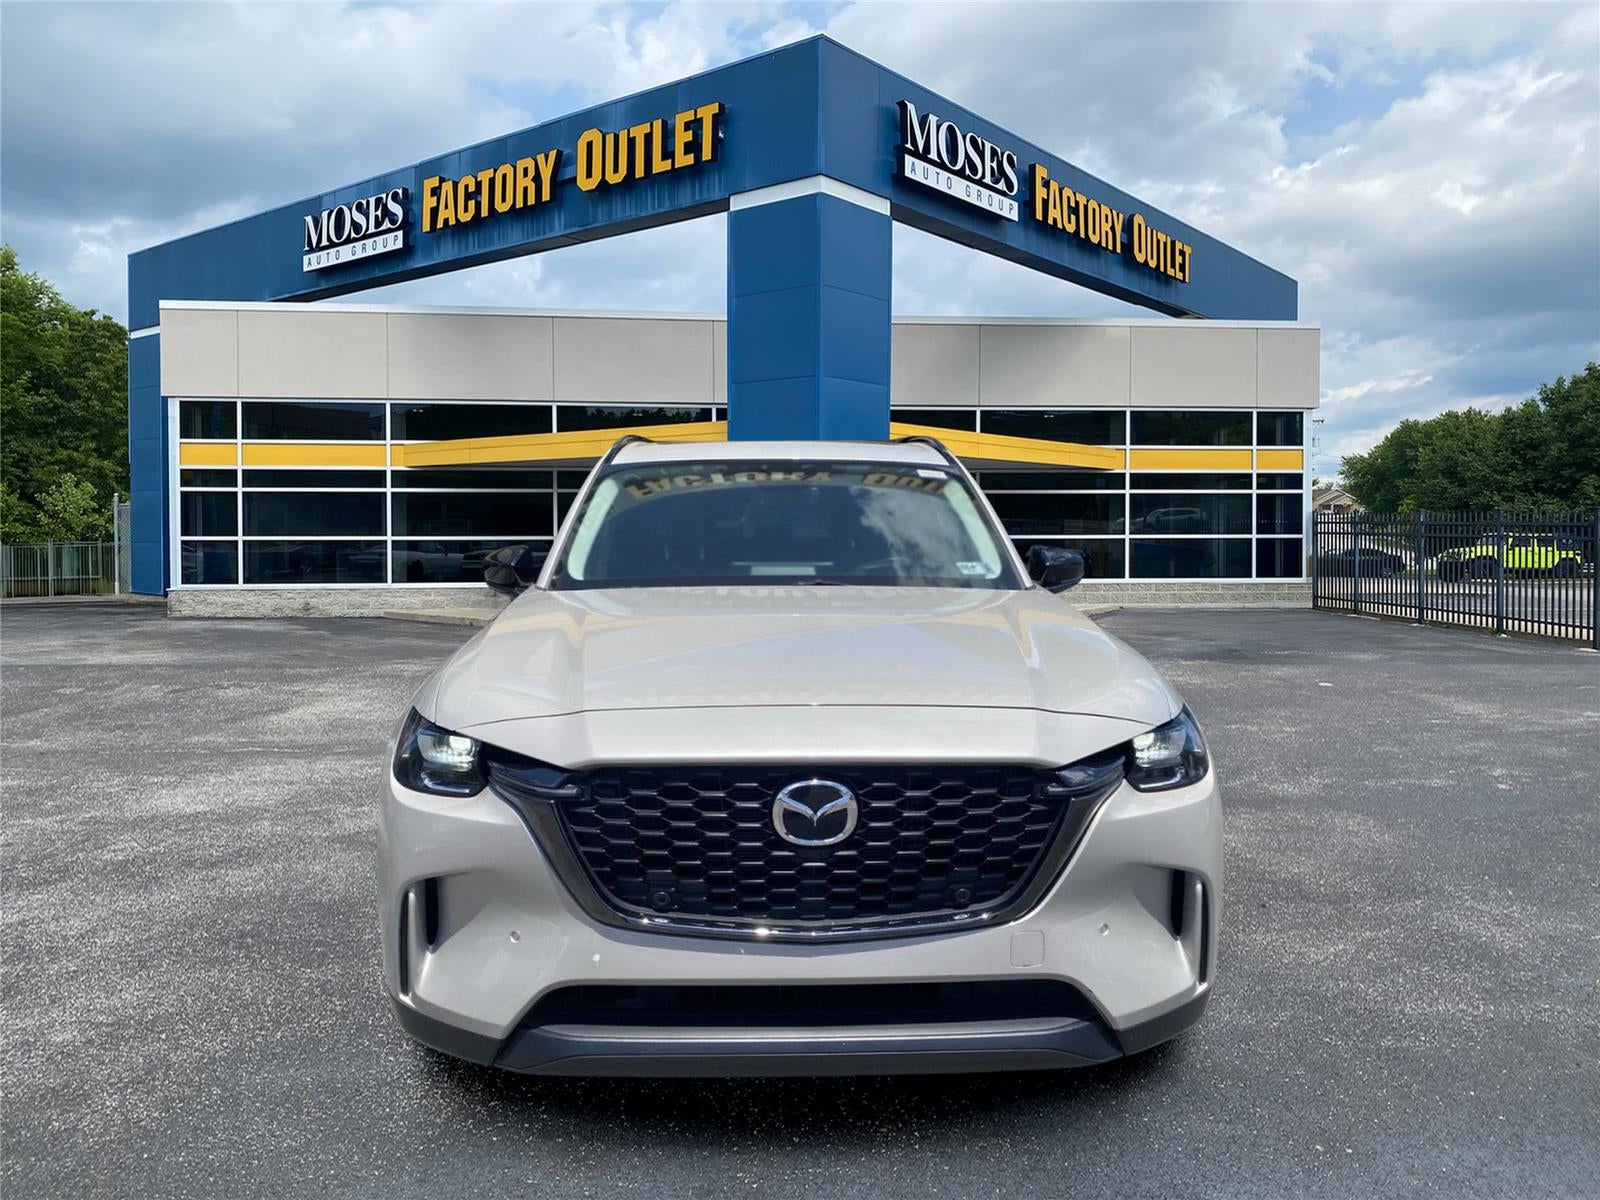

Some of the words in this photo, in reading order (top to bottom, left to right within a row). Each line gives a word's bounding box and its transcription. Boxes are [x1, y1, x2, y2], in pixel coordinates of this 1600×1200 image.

[422, 148, 558, 233] FACTORY
[576, 101, 720, 192] OUTLET
[904, 100, 1018, 196] MOSES
[910, 161, 952, 190] AUTO
[965, 184, 1014, 214] GROUP
[303, 187, 403, 251] MOSES
[307, 249, 340, 267] AUTO
[351, 234, 399, 256] GROUP
[1035, 163, 1124, 254] FACTORY
[1133, 213, 1192, 283] OUTLET
